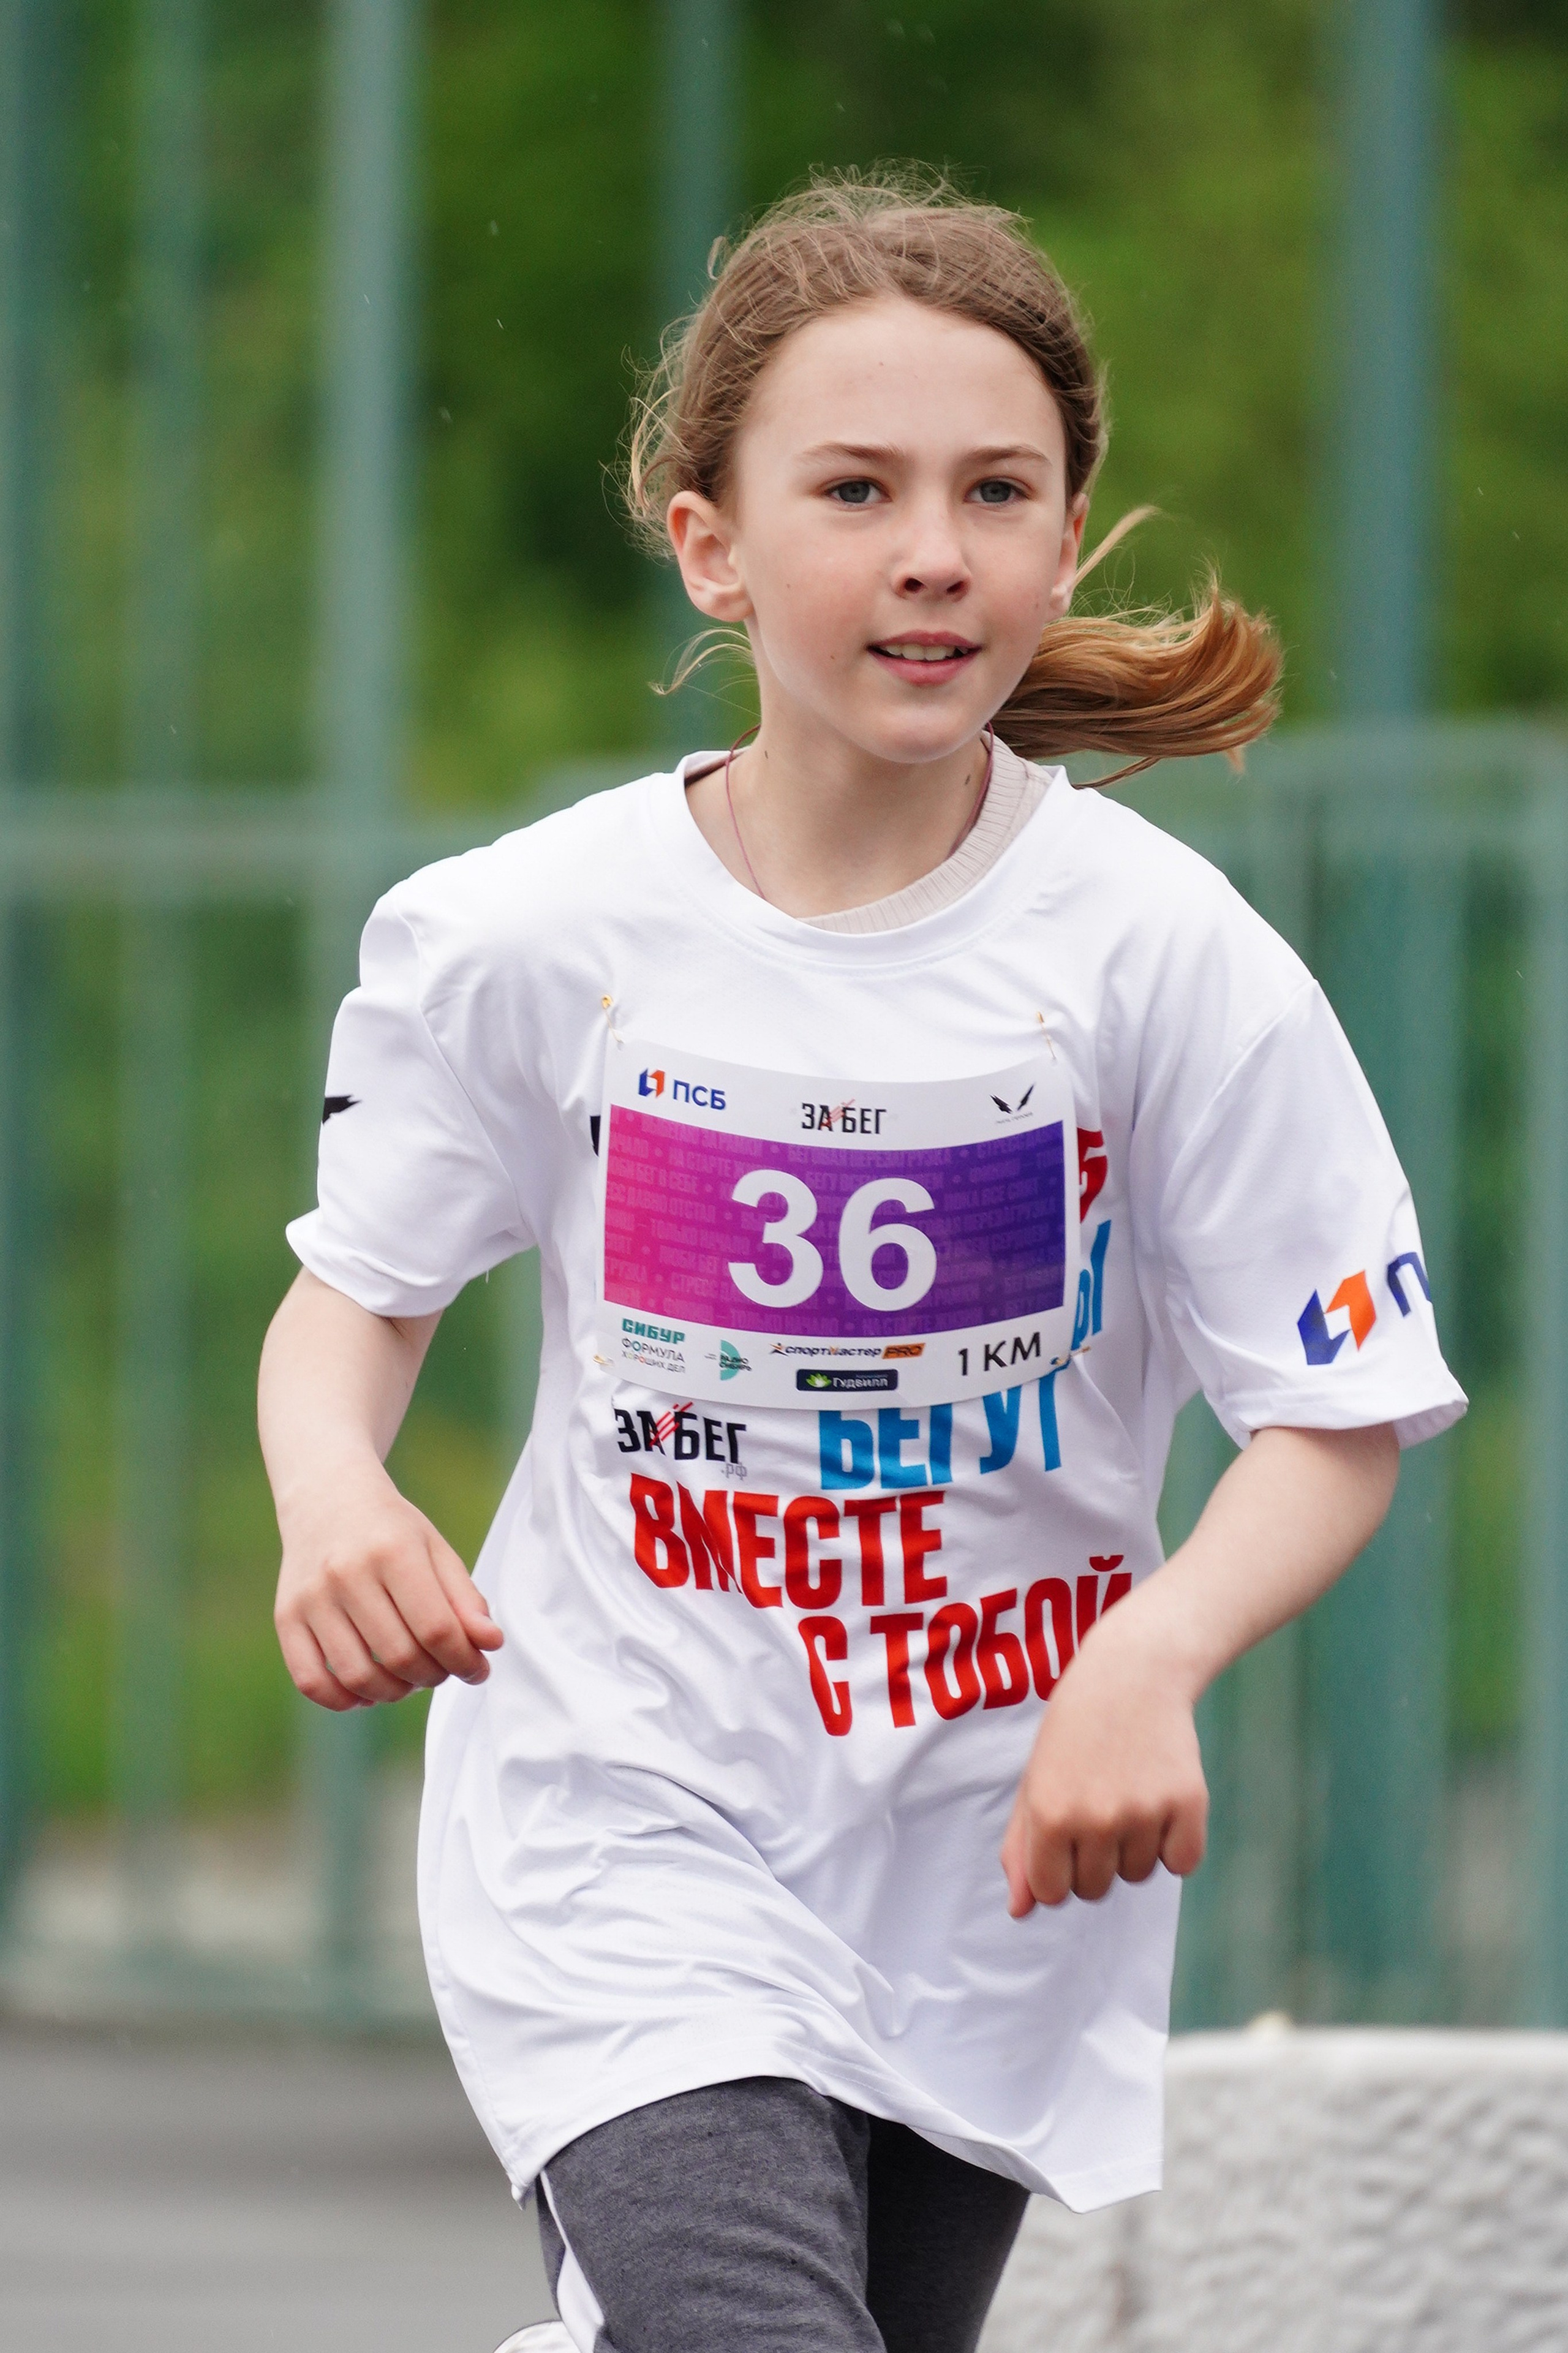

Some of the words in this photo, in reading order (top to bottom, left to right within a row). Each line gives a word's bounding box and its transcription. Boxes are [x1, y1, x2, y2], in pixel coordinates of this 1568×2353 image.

[673, 1079, 726, 1111] ПСБ
[728, 1169, 937, 1312] 36
[622, 1318, 685, 1345] СИБУР
[622, 1337, 685, 1363] ФОРМУЛА
[886, 1344, 925, 1359] PRO
[959, 1348, 969, 1377] 1
[984, 1332, 1041, 1372] КМ
[630, 1472, 948, 1610] ВМЕСТЕ
[798, 1615, 851, 1737] С
